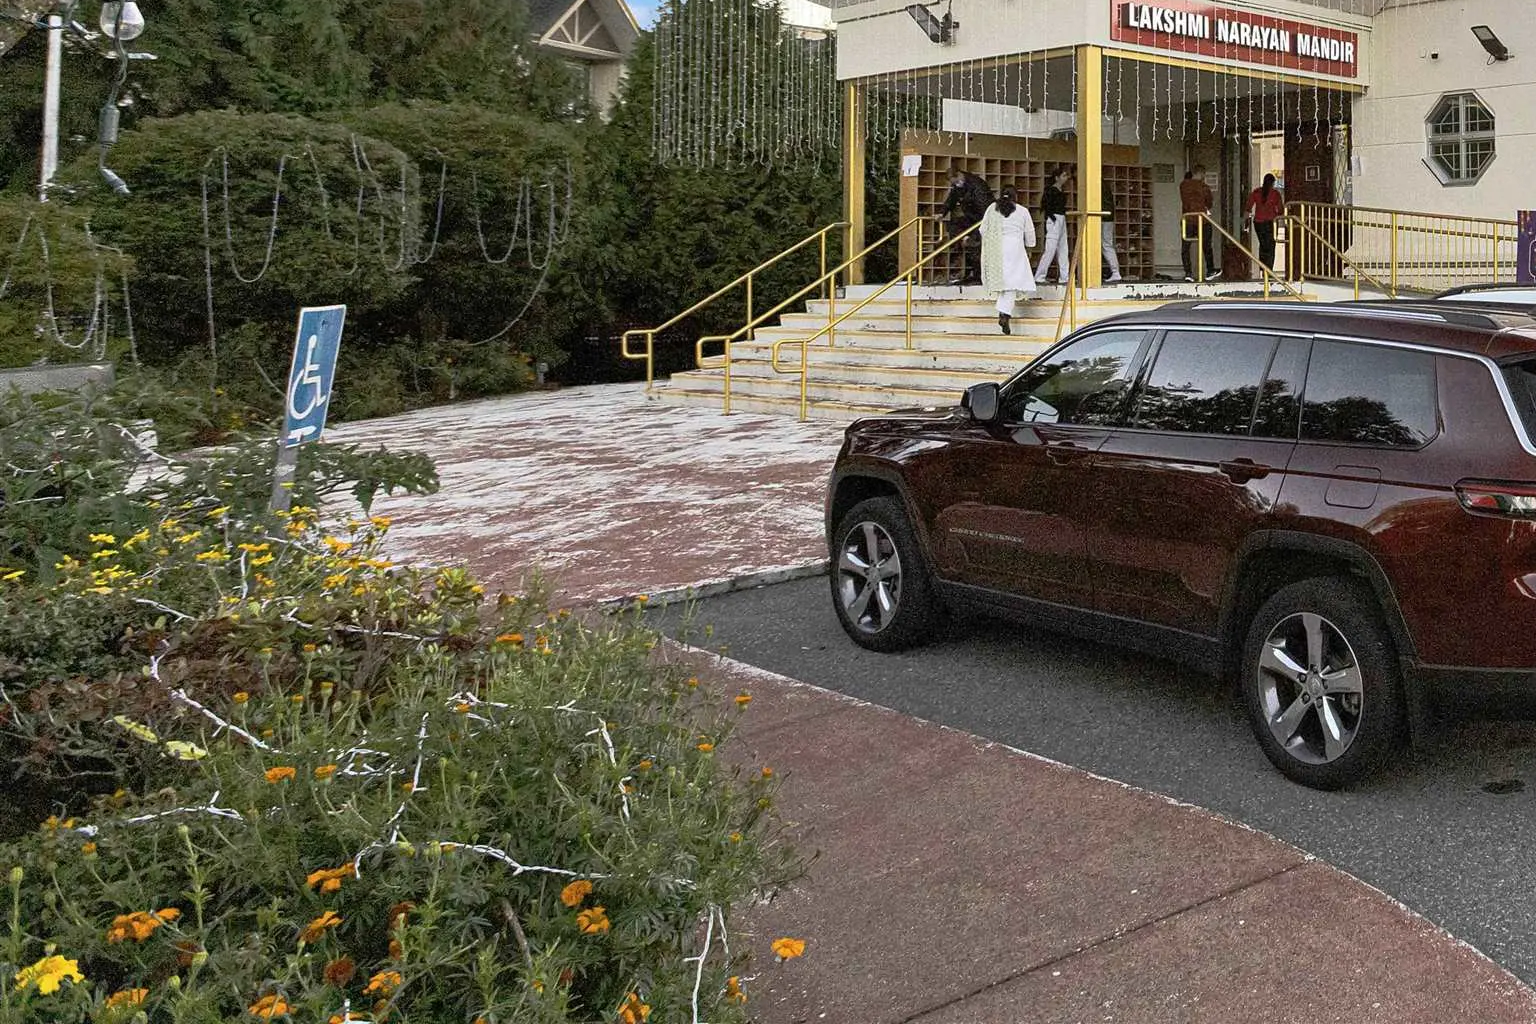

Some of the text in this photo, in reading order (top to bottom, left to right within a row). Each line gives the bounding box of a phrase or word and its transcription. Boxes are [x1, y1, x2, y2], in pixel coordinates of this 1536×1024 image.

[1128, 2, 1354, 63] LAKSHMI NARAYAN MANDIR
